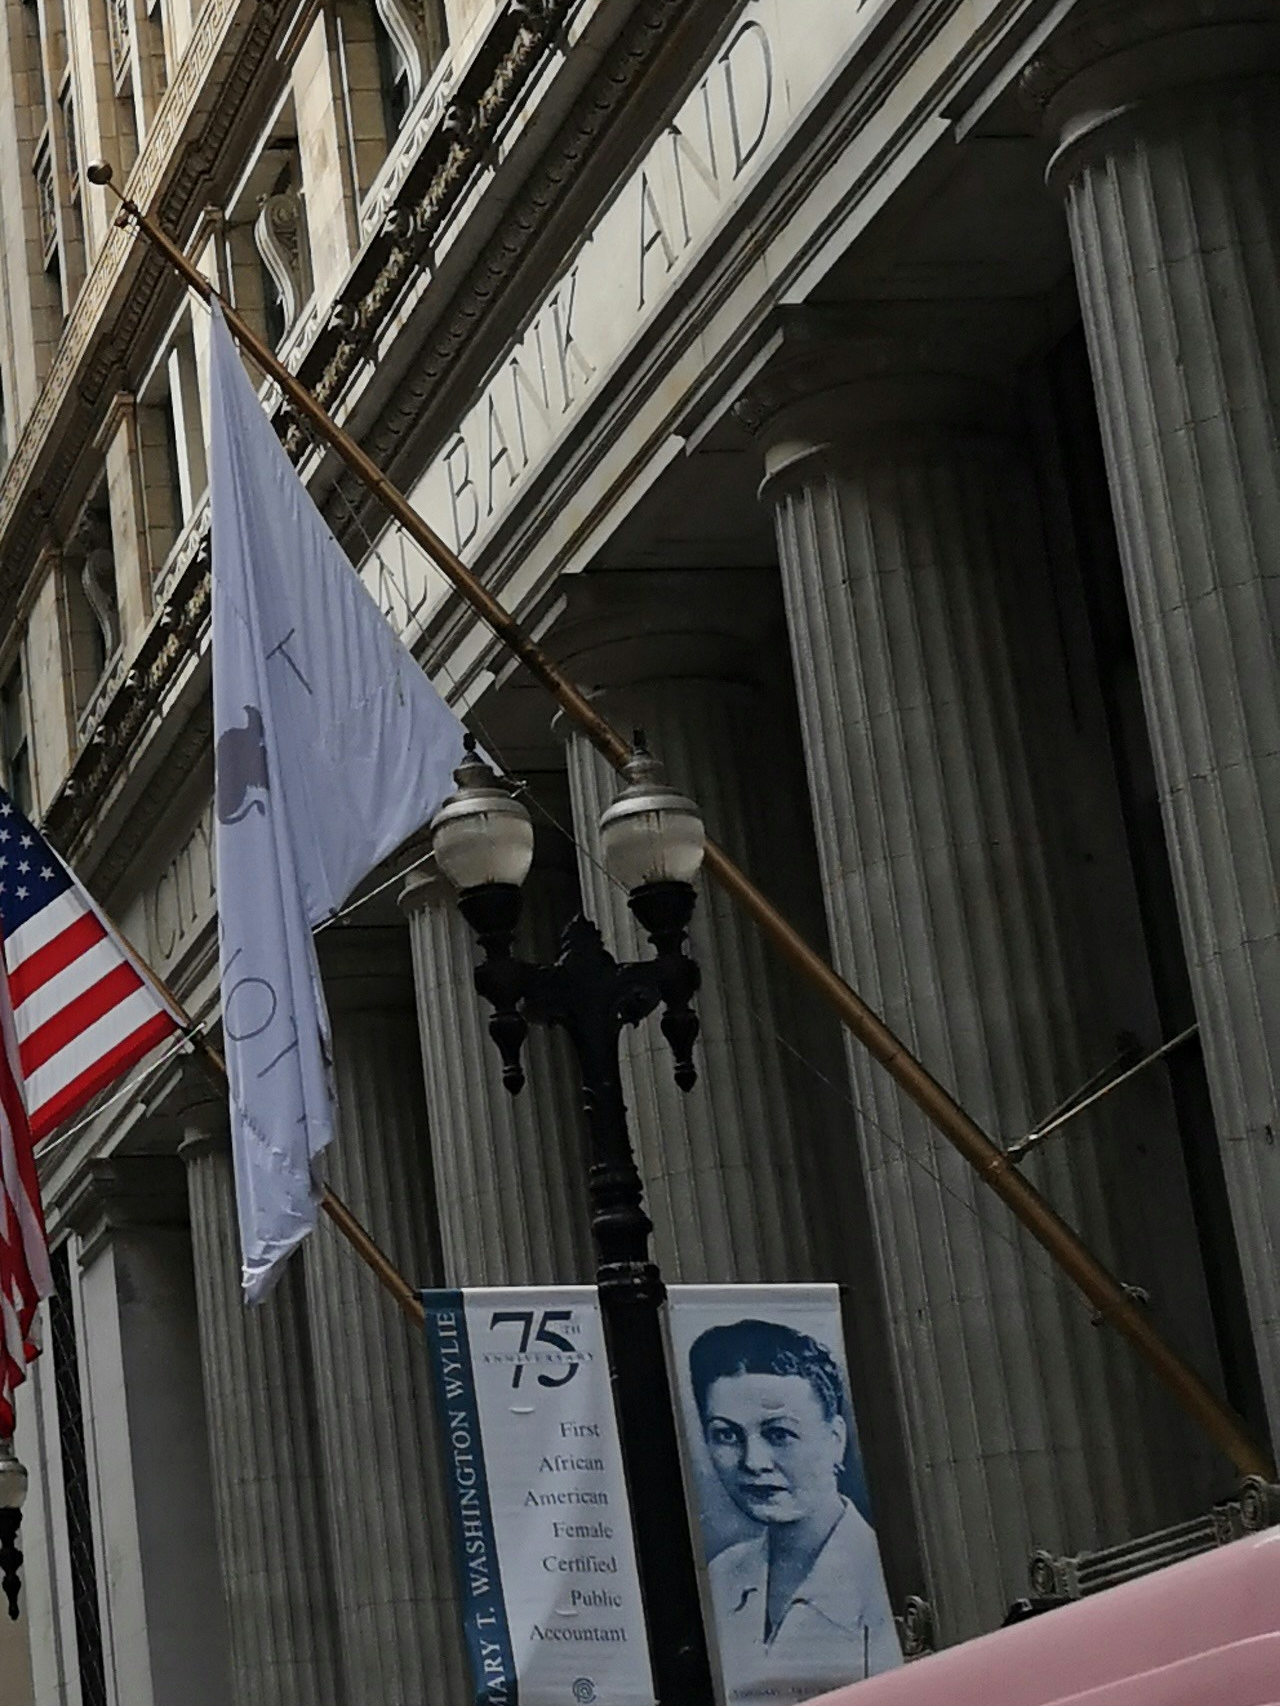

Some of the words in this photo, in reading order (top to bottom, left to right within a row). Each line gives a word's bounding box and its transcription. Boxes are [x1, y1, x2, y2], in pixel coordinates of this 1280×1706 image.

[442, 265, 597, 558] BANK
[637, 20, 773, 311] AND
[437, 1310, 464, 1400] WYLIE
[560, 1421, 600, 1438] First
[539, 1456, 605, 1473] African
[447, 1410, 491, 1597] WASHINGTON
[524, 1489, 610, 1507] American
[553, 1521, 614, 1539] Female
[542, 1554, 618, 1573] Certified
[570, 1588, 623, 1607] Public
[475, 1606, 498, 1631] T.
[529, 1624, 628, 1643] Accountant
